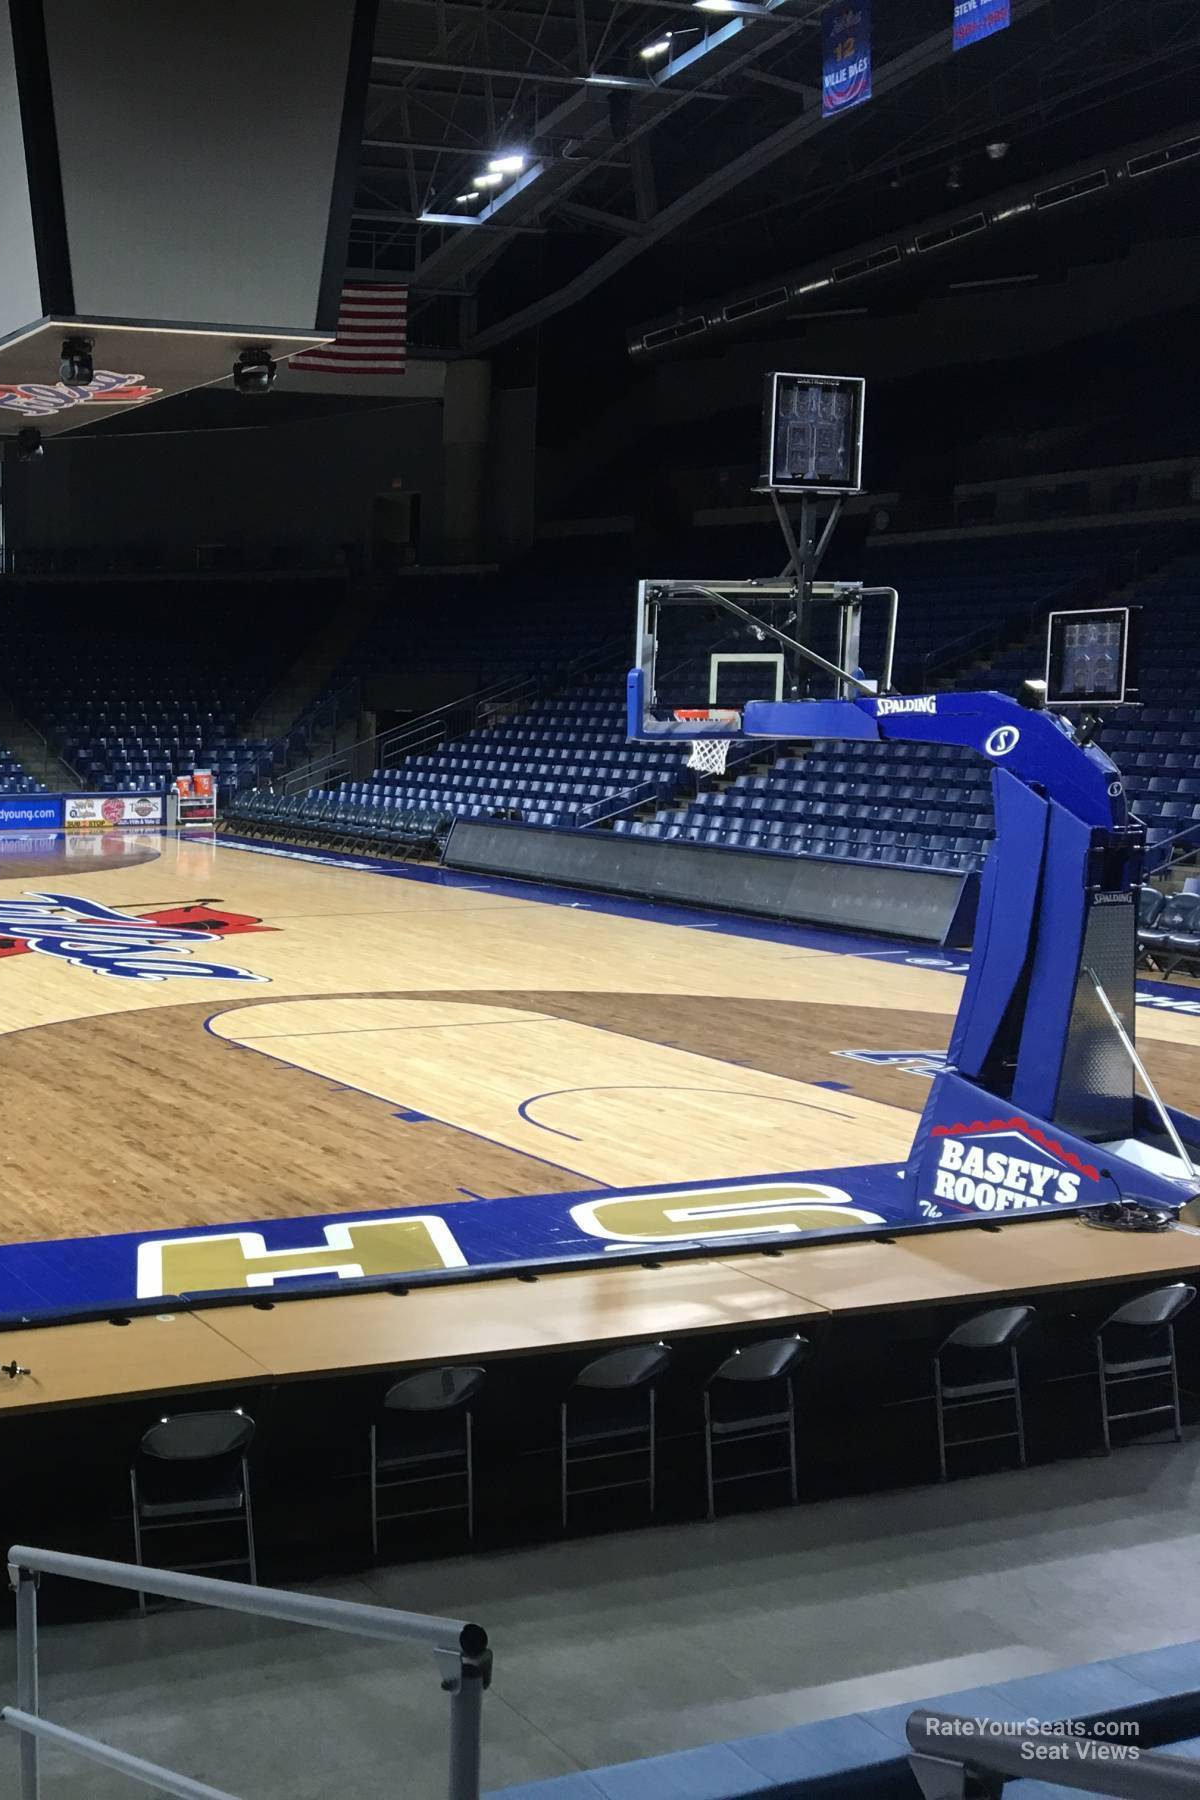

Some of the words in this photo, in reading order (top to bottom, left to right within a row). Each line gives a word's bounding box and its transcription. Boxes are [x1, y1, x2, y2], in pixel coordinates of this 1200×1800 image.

[876, 694, 937, 717] SPALDING
[1094, 893, 1132, 906] SPALDING
[937, 1138, 1080, 1205] BASEY'S
